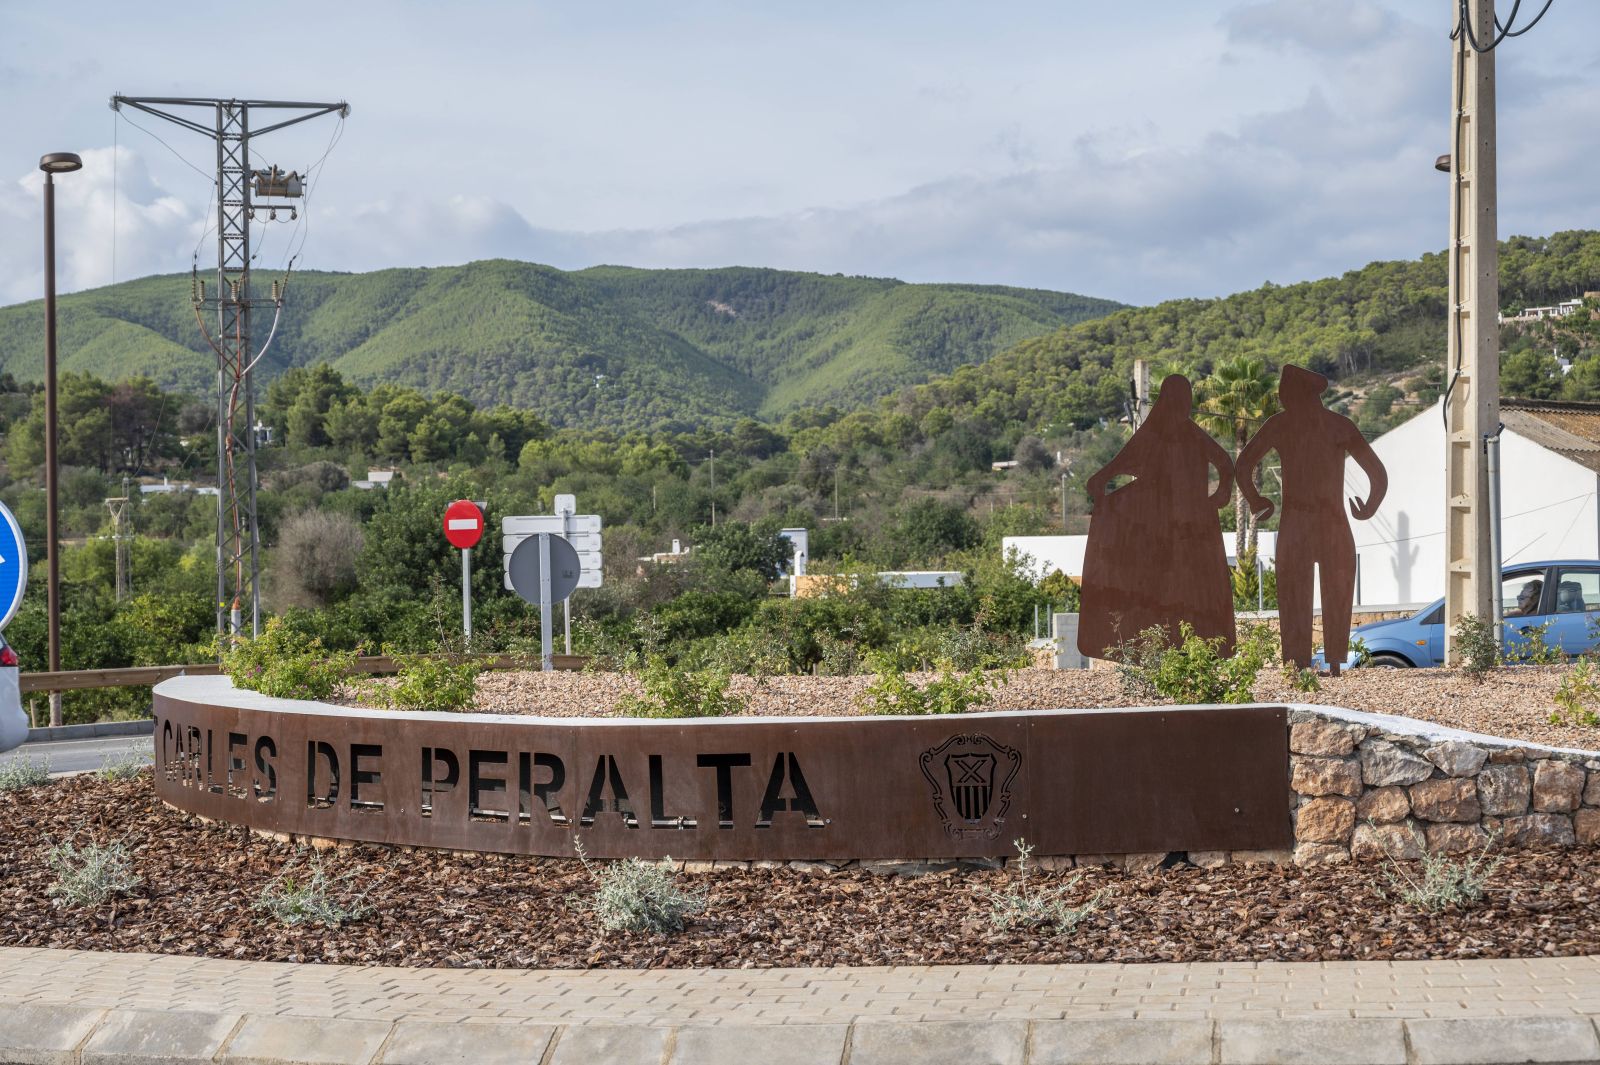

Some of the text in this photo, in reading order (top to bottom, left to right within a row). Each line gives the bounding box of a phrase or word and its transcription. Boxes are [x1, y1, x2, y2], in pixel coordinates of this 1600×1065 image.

[163, 719, 277, 803] CARLES
[307, 740, 384, 815] DE
[421, 747, 825, 829] PERALTA
